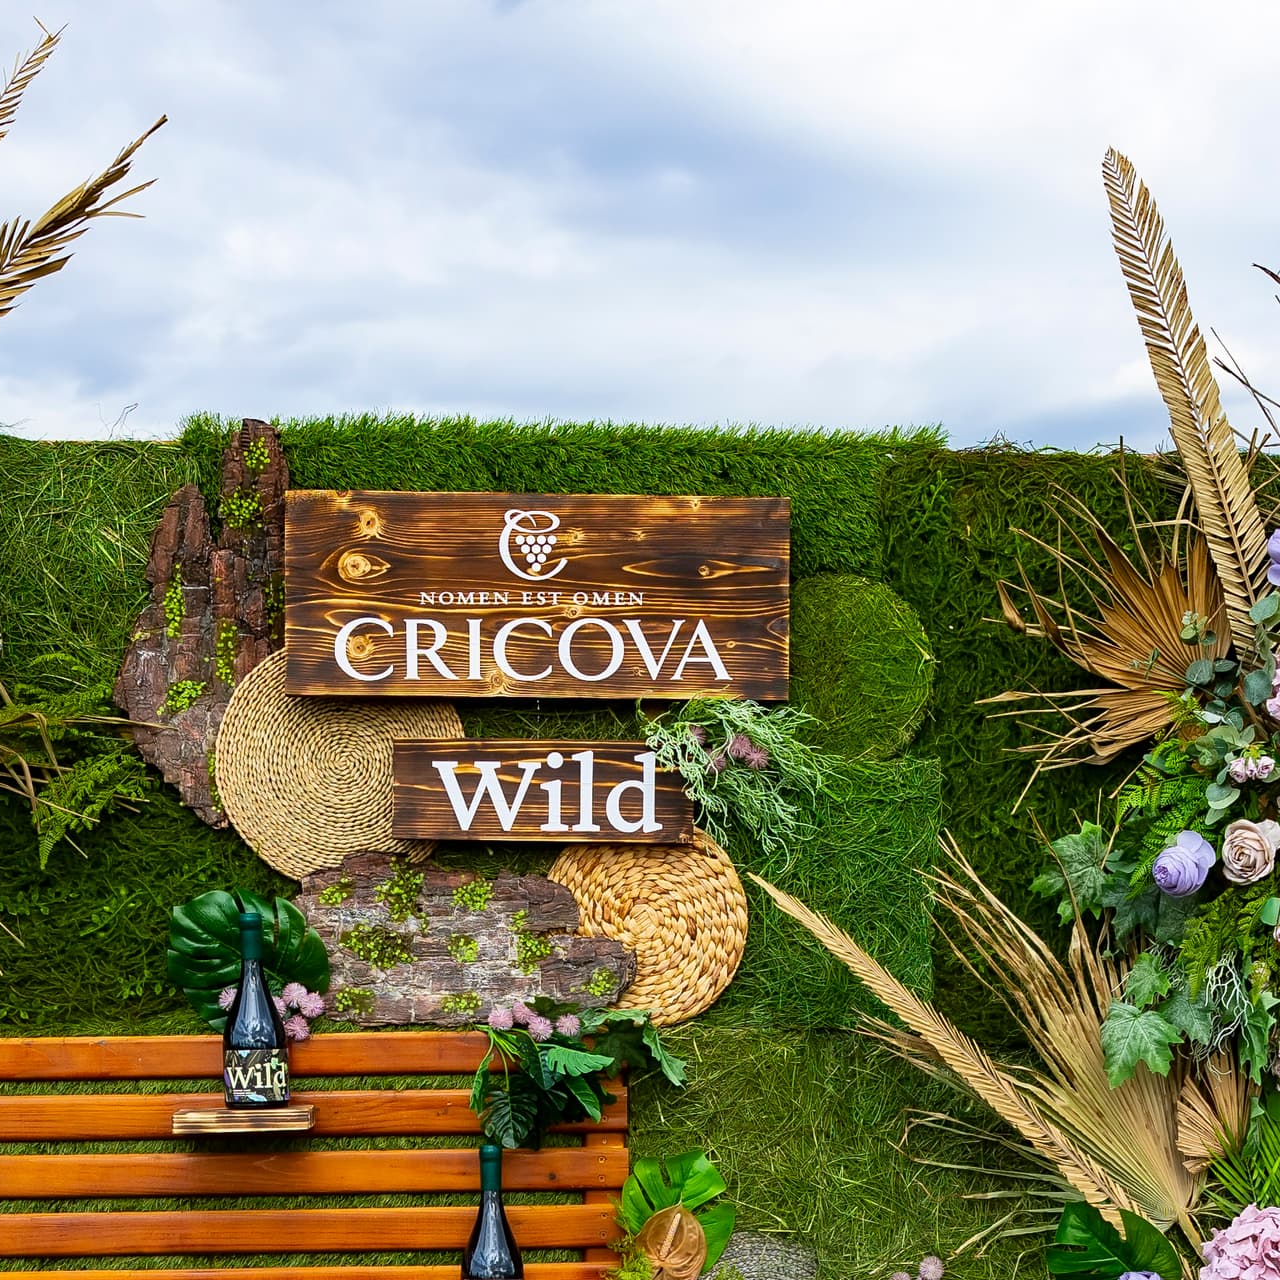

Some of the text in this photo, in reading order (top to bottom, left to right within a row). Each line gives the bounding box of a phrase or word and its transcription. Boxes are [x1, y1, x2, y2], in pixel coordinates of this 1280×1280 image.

[420, 591, 644, 606] NOMEN EST OMEN
[333, 617, 734, 682] CRICOVA
[431, 750, 663, 833] Wild
[226, 1062, 287, 1089] Wild
